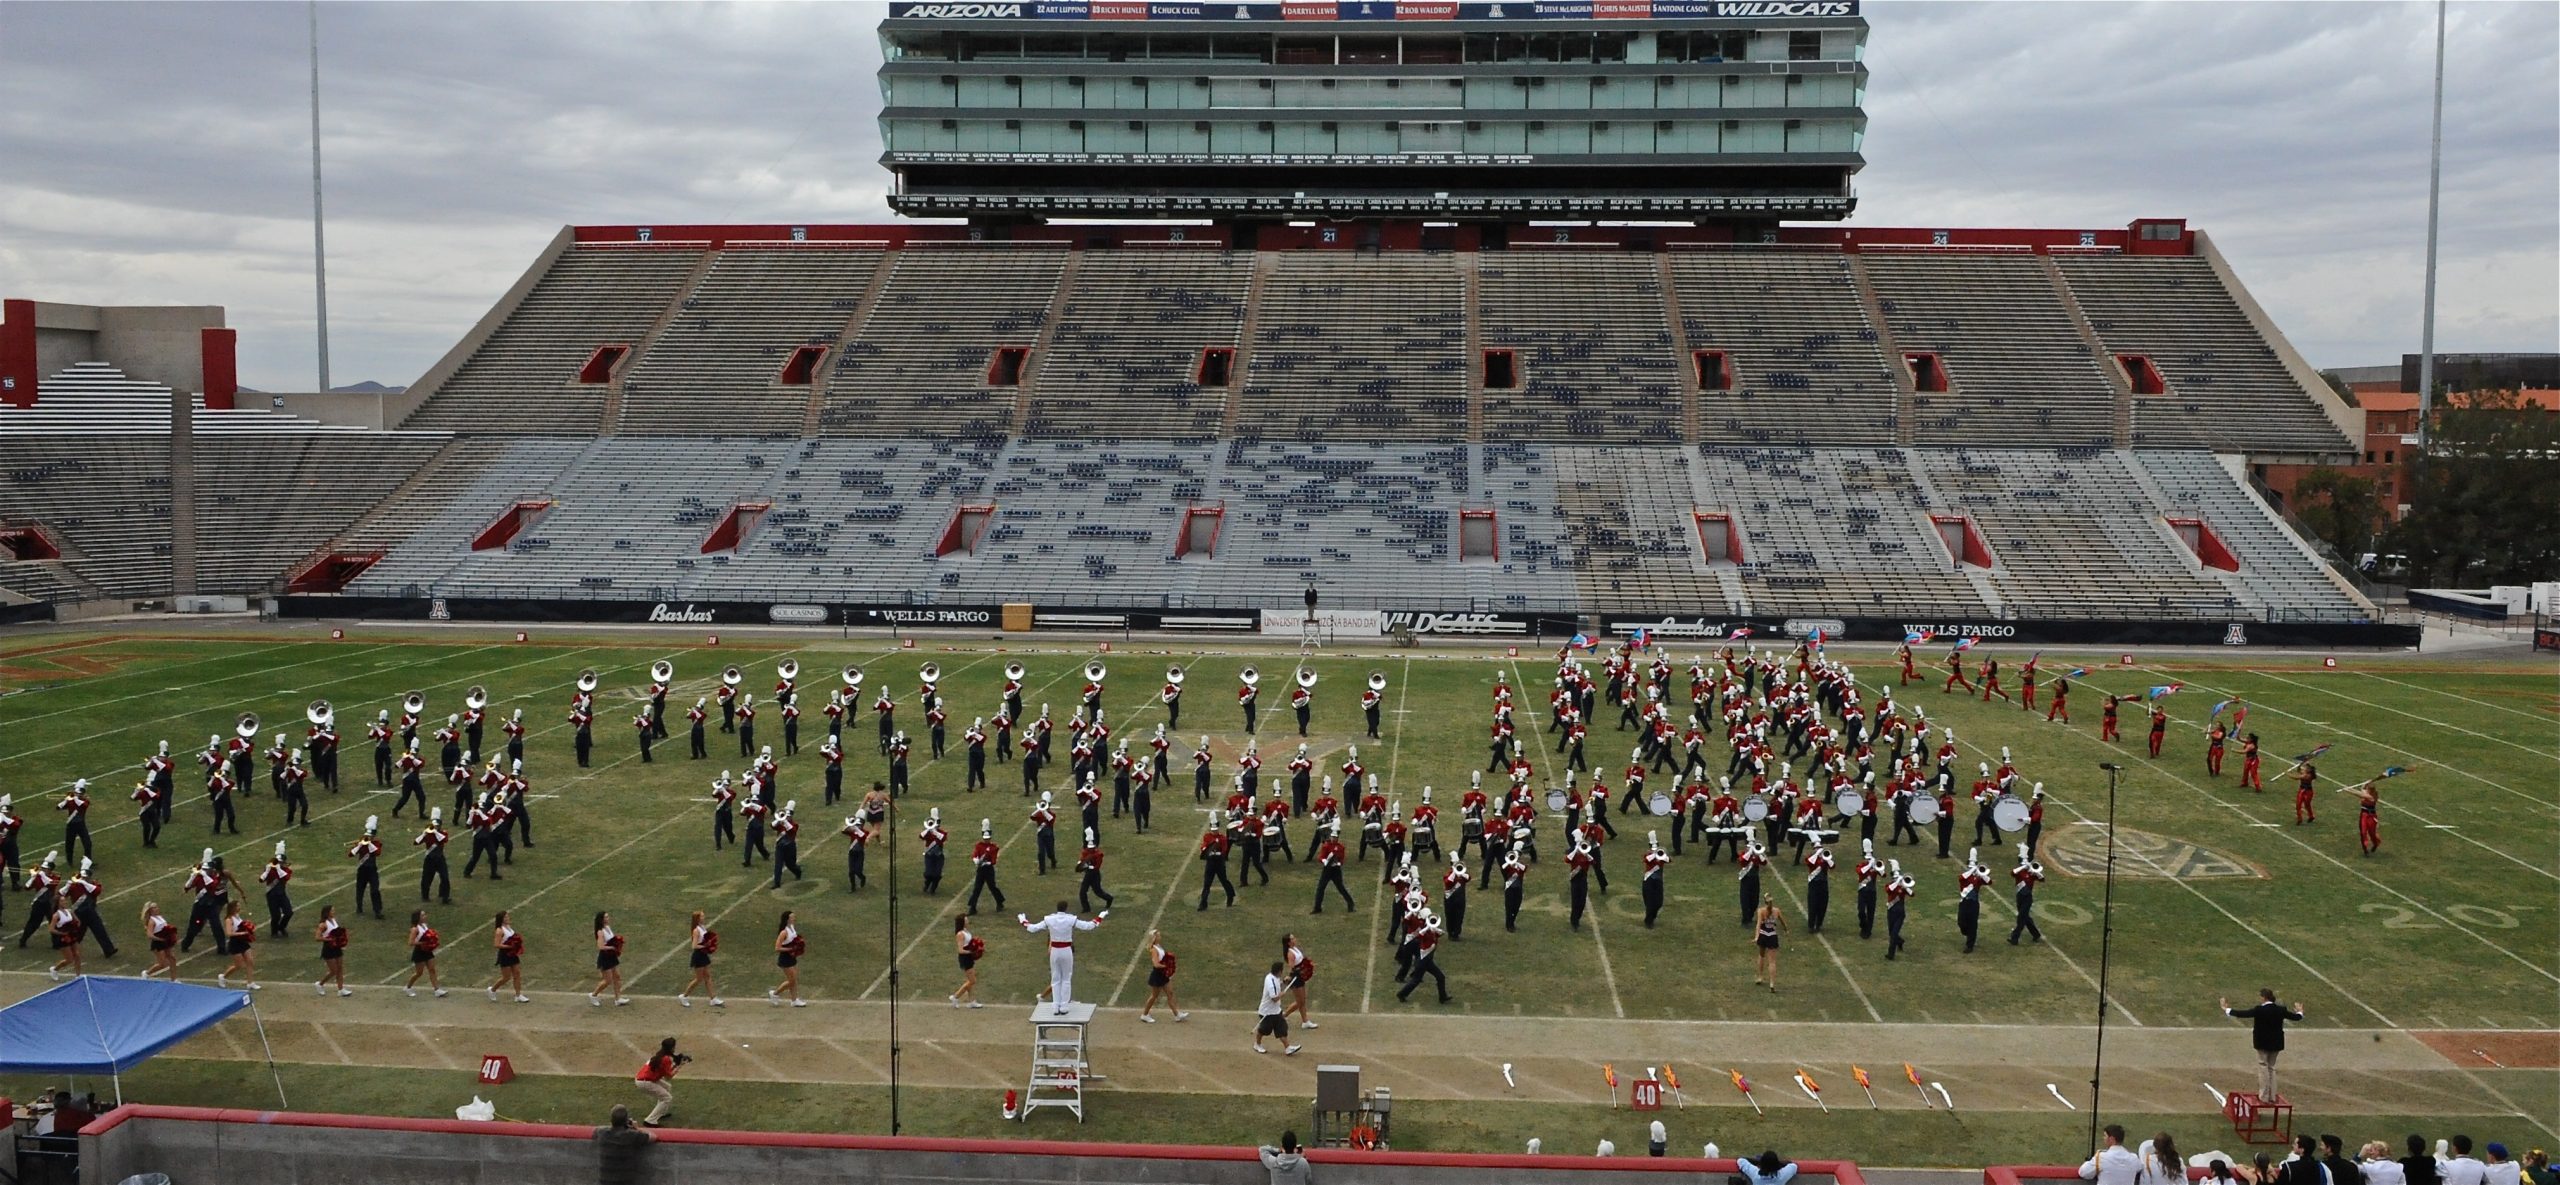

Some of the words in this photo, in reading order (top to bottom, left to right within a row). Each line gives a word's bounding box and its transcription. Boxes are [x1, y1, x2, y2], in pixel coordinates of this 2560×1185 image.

[903, 4, 1021, 18] ARIZONA
[1158, 7, 1181, 15] CHUCK
[1182, 7, 1201, 15] CECIL
[1287, 7, 1316, 15] DARRYLL
[1317, 7, 1337, 15] LEWIS
[1404, 6, 1419, 14] ROB
[1420, 6, 1451, 14] WALDROP
[1657, 5, 1685, 13] ANTOINE
[1686, 5, 1708, 13] CASON
[1717, 2, 1852, 16] WILDCATS
[639, 232, 650, 242] 17
[793, 232, 805, 241] 18
[969, 232, 981, 242] 19
[1169, 232, 1183, 241] 20
[1323, 232, 1335, 242] 21
[1555, 234, 1568, 243] 22
[1934, 236, 1948, 245] 24
[2081, 237, 2095, 246] 25
[3, 379, 15, 388] 15
[273, 397, 284, 406] 16
[648, 603, 716, 622] Bashas'
[882, 610, 935, 622] WELLS
[938, 610, 990, 622] FARGO
[1343, 617, 1363, 628] BAND
[1364, 617, 1377, 628] DAY
[1961, 625, 2014, 637] FARGO
[2358, 903, 2520, 929] 20
[481, 1059, 501, 1080] 40
[1636, 1085, 1656, 1106] 40
